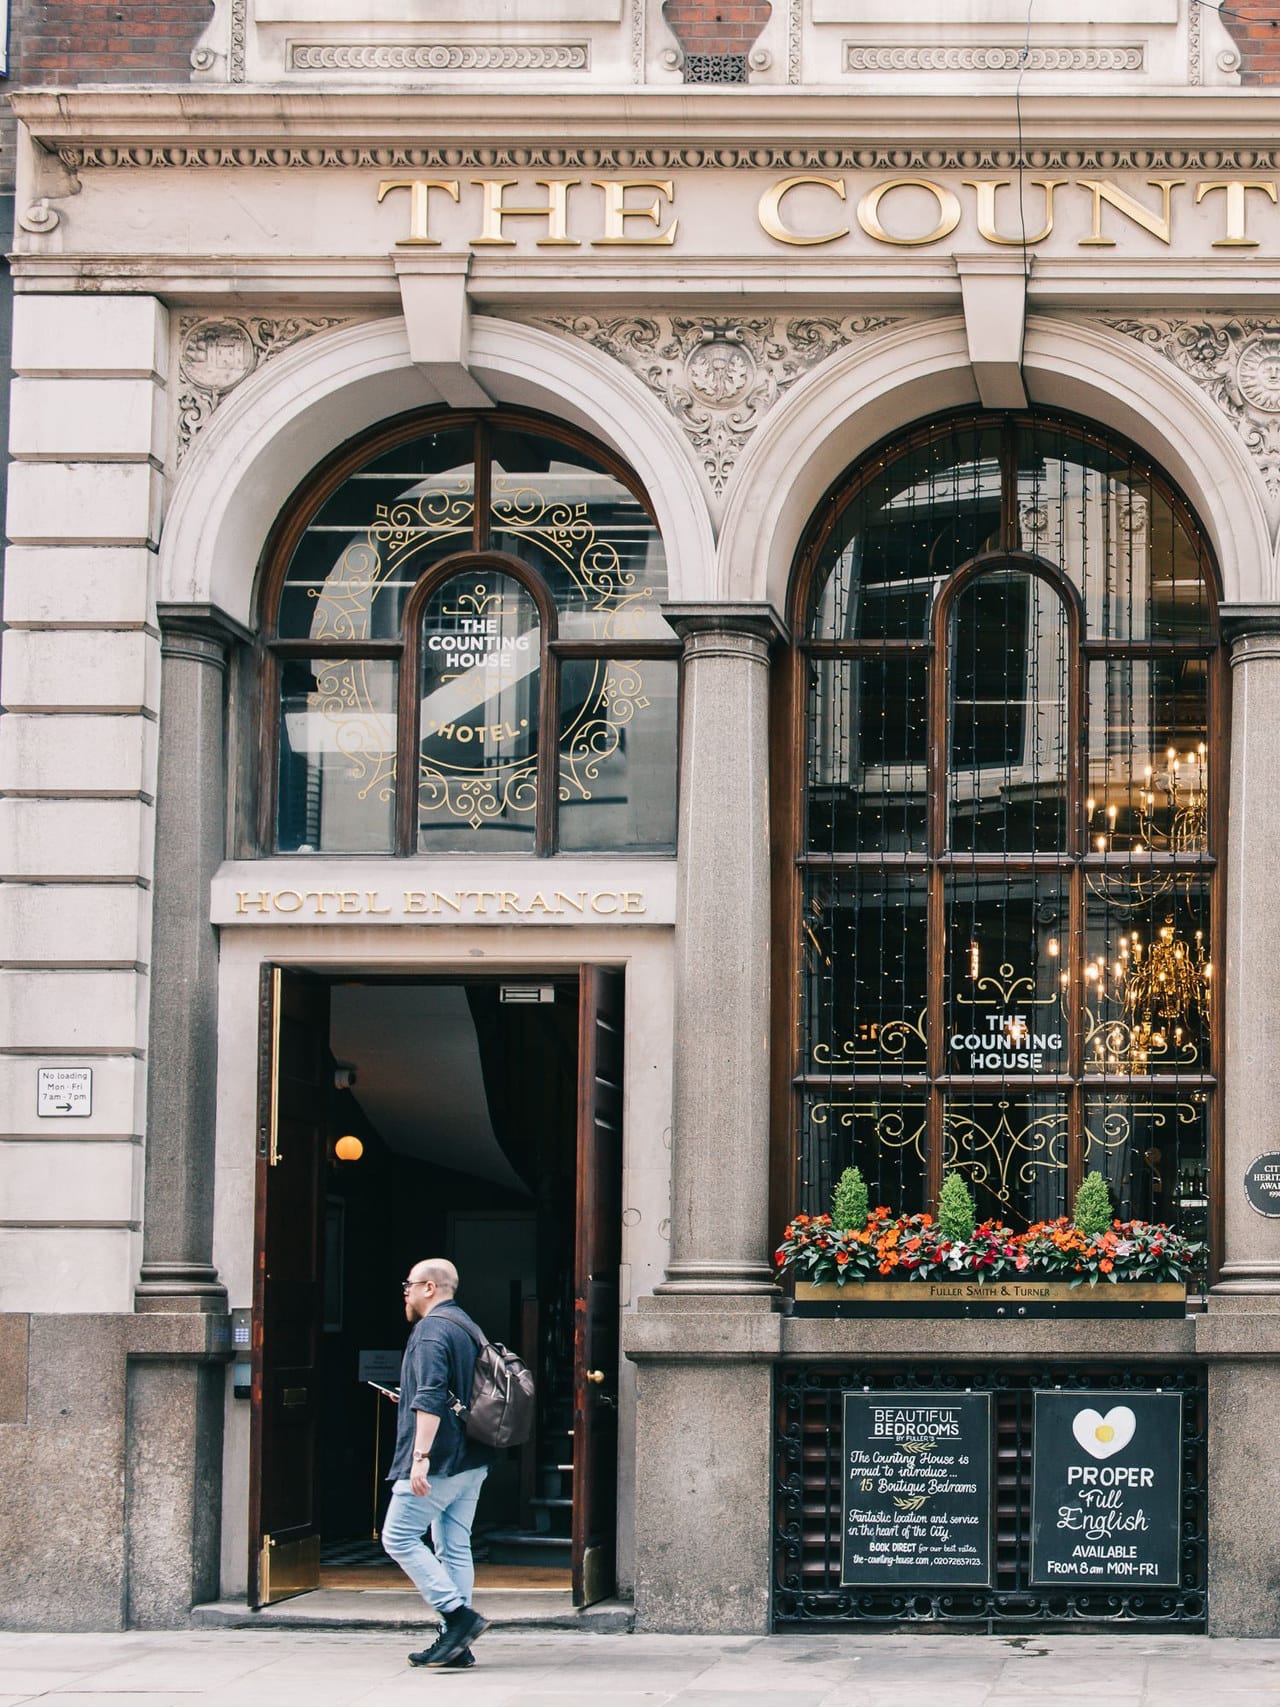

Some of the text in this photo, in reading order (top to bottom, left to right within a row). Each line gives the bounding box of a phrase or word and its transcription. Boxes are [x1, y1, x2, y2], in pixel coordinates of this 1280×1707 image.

[377, 178, 679, 246] THE
[460, 619, 498, 634] THE
[428, 636, 529, 651] COUNTING
[446, 653, 511, 668] HOUSE
[437, 721, 520, 743] HOTEL
[235, 890, 648, 914] HOTEL ENTRANCE
[985, 1015, 1027, 1031] THE
[950, 1034, 1062, 1050] COUNTING
[970, 1053, 1043, 1069] HOUSE
[930, 1285, 1050, 1297] FULLER SMITH & TURNER
[874, 1409, 958, 1423] BEAUTIFUL
[874, 1423, 960, 1436] BEDROOMS
[850, 1450, 970, 1469] The Counting House is
[850, 1464, 880, 1479] proud
[881, 1465, 895, 1477] to
[1067, 1465, 1155, 1488] PROPER
[859, 1478, 978, 1497] 15 Boutique Bedrooms
[1078, 1488, 1124, 1509] Full
[848, 1508, 980, 1525] Fantastic location and service
[1056, 1506, 1149, 1540] English
[847, 1524, 953, 1543] in the heart of the City.
[869, 1542, 890, 1553] BOOK
[891, 1542, 917, 1554] DIRECT
[918, 1544, 929, 1554] for
[929, 1546, 942, 1554] our
[943, 1544, 957, 1554] best
[1072, 1545, 1138, 1559] AVAILABLE
[1047, 1560, 1078, 1574] FROM
[1106, 1561, 1159, 1576] MON-FRI
